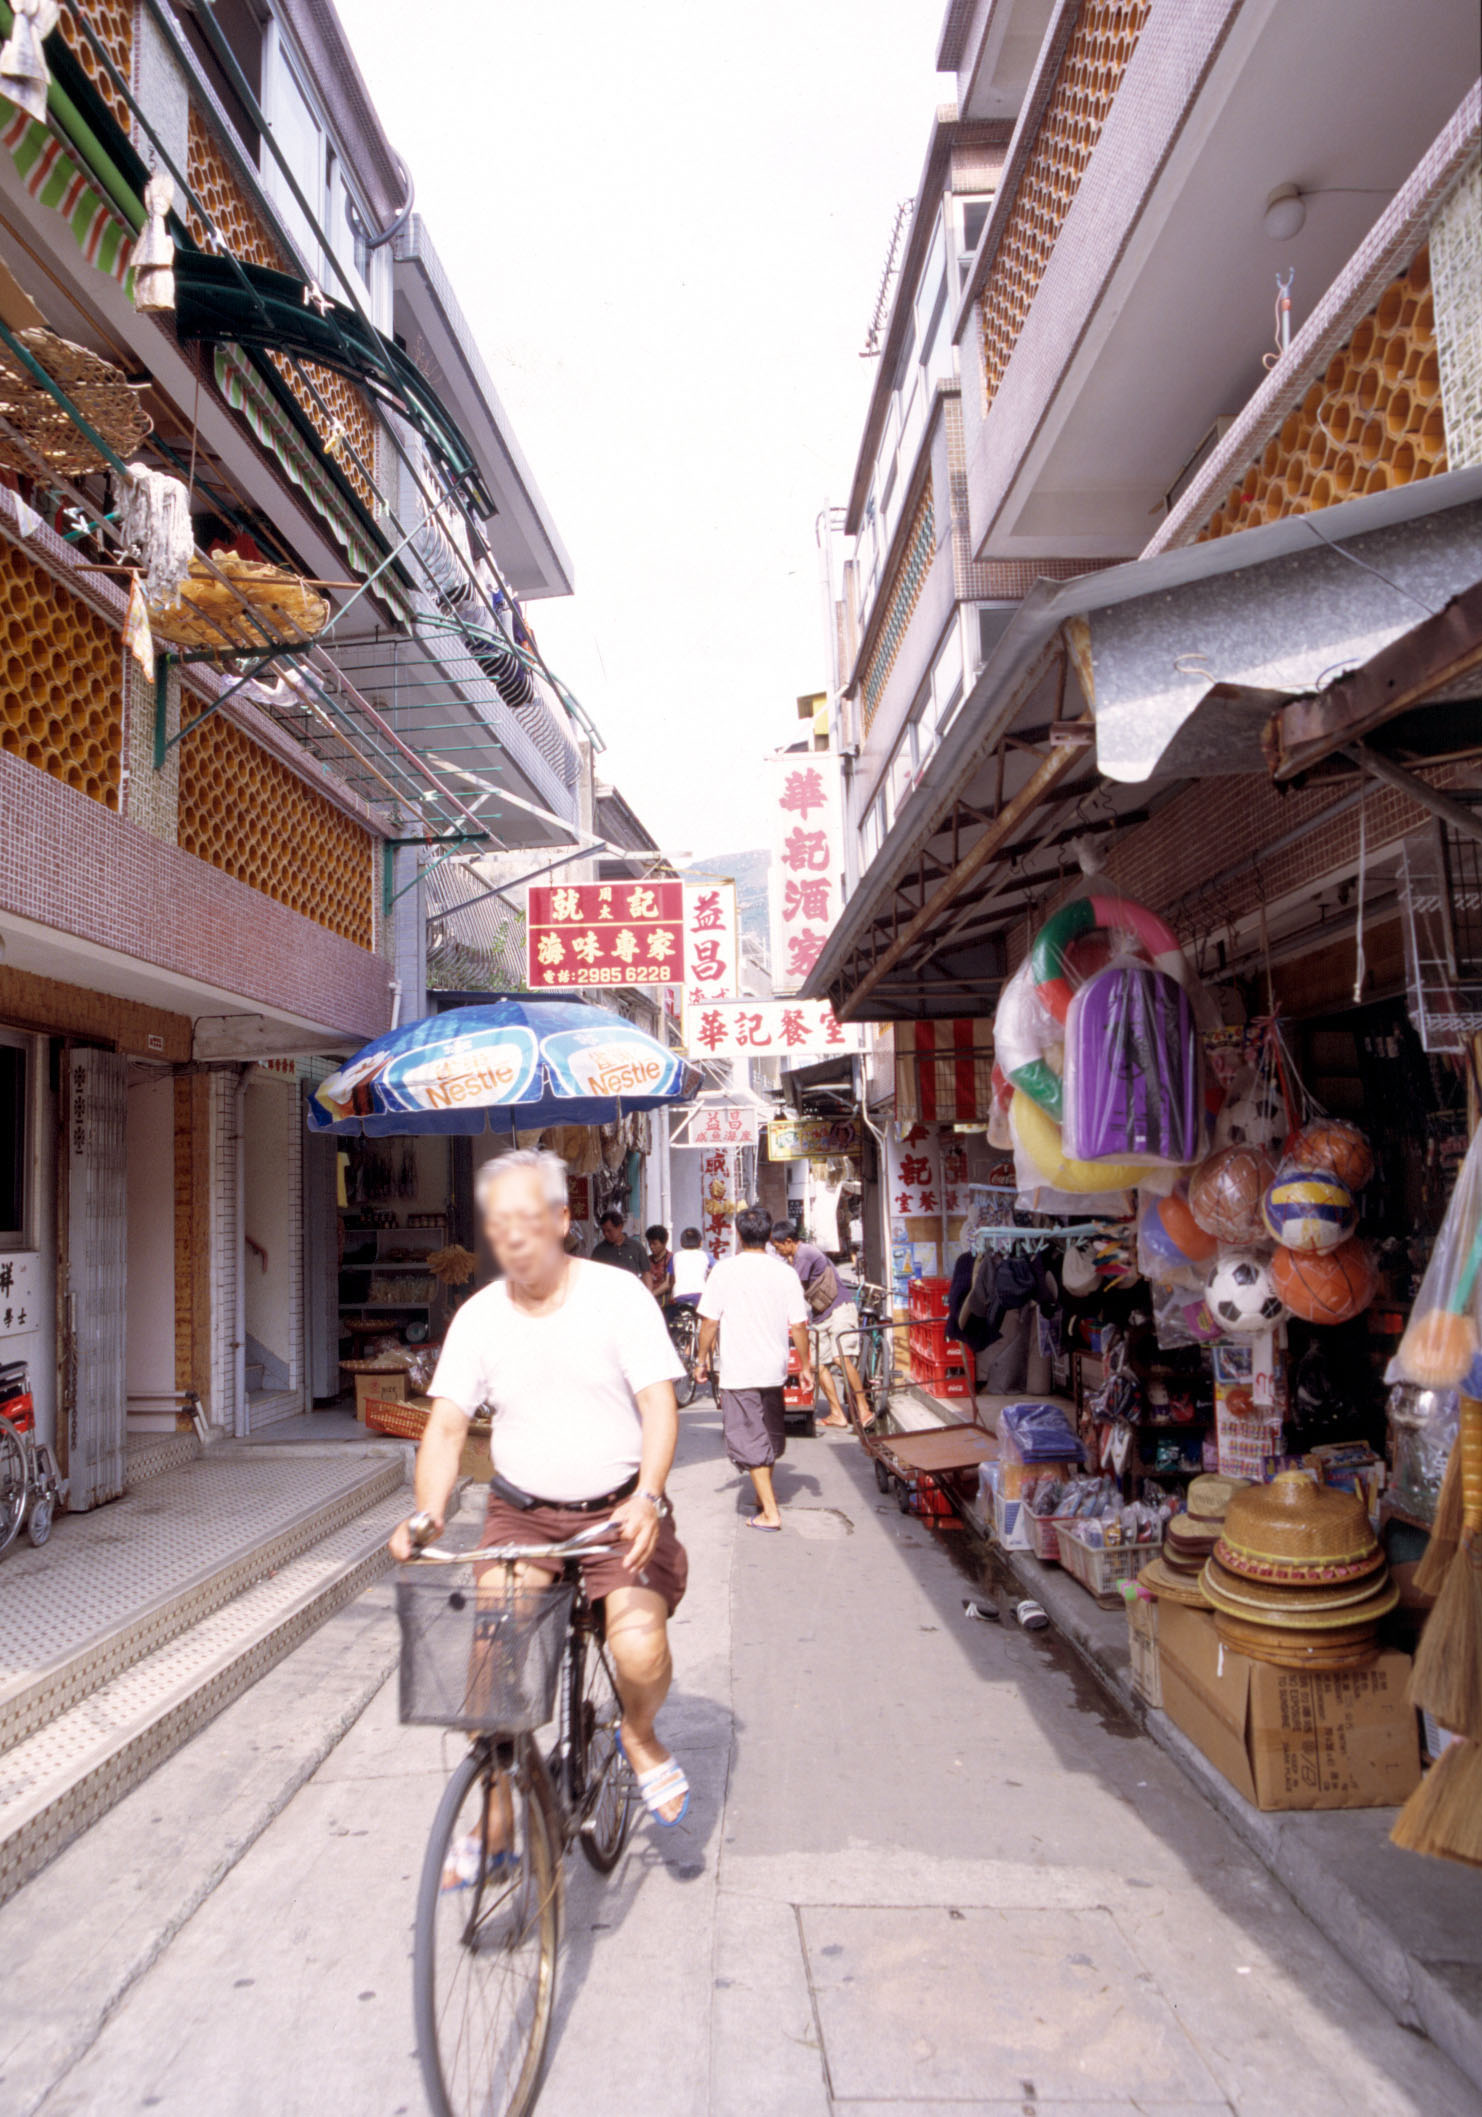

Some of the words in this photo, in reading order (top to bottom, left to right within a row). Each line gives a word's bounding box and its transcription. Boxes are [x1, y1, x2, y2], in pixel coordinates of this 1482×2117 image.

[779, 767, 832, 977] 華記酒家
[537, 928, 676, 966] 海味專家
[689, 890, 727, 982] 益昌
[697, 1008, 847, 1052] 華記餐室
[705, 1111, 743, 1131] 益昌
